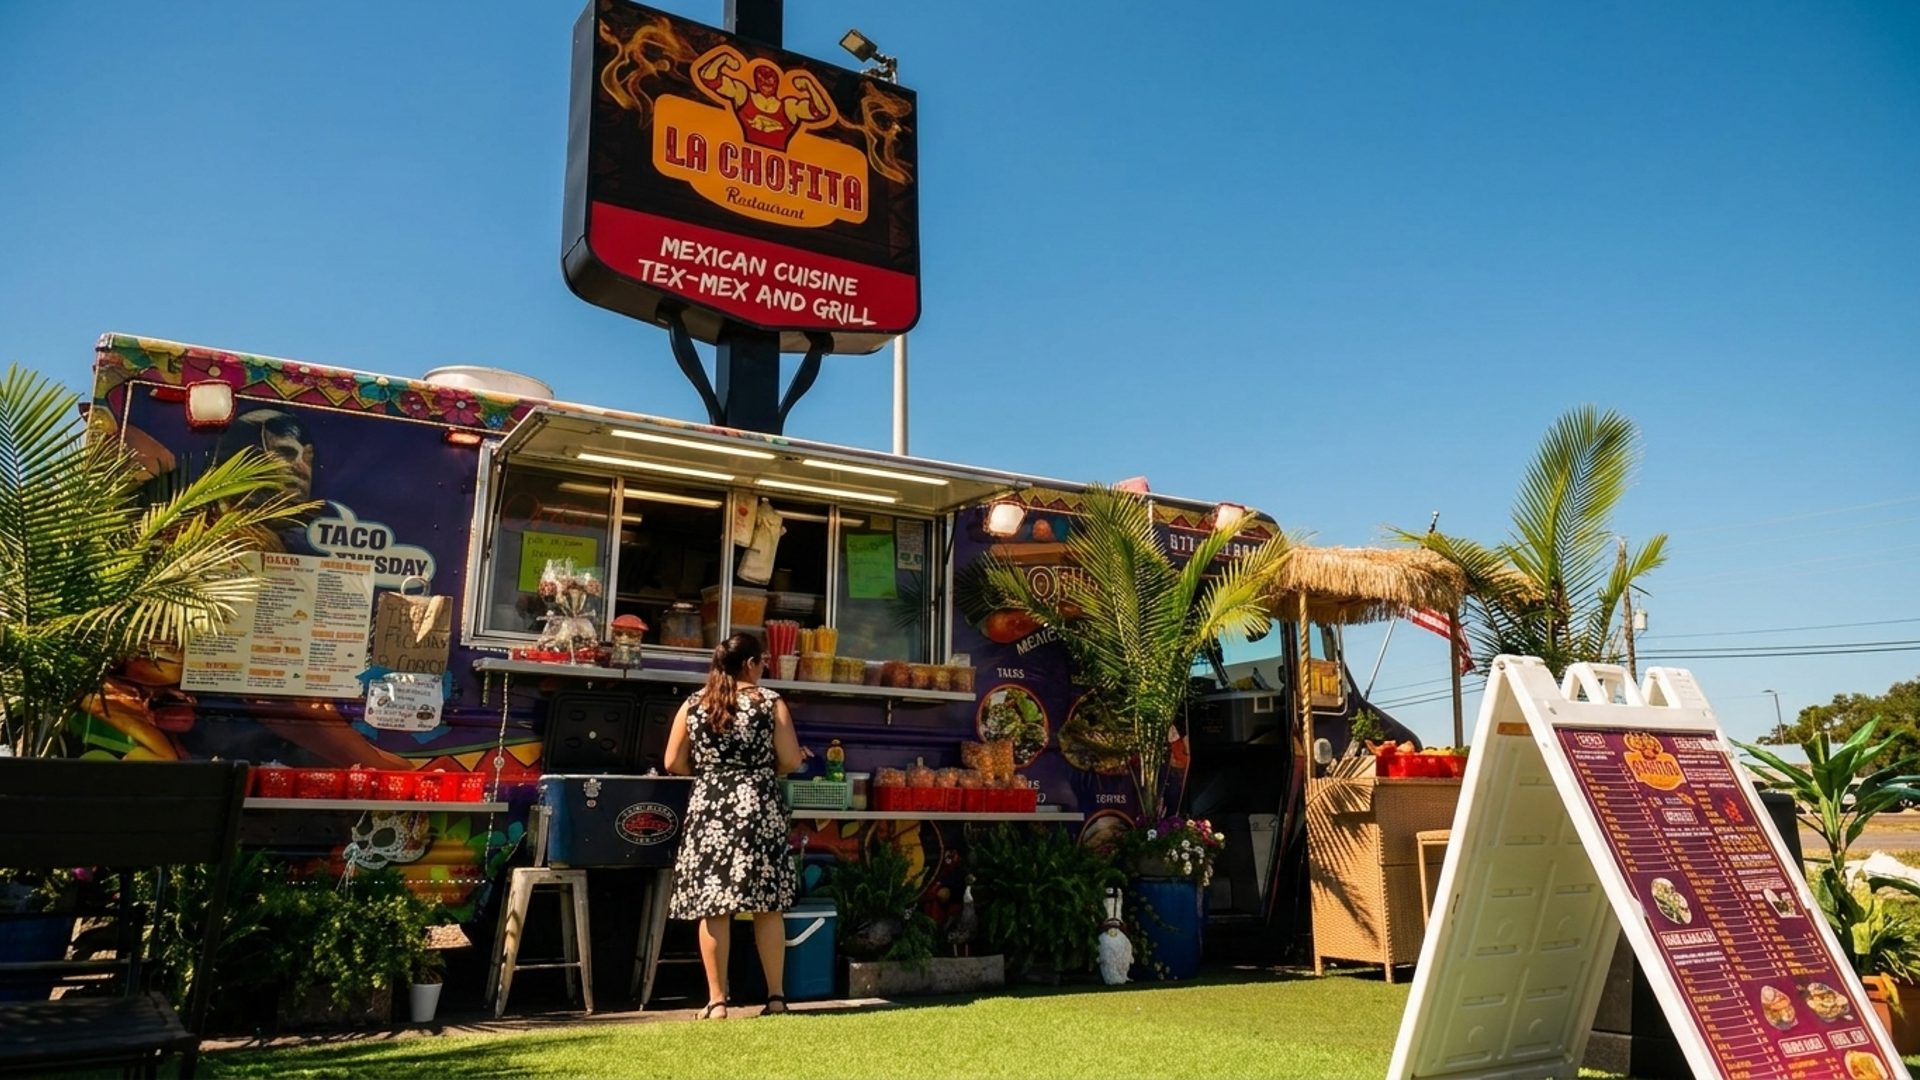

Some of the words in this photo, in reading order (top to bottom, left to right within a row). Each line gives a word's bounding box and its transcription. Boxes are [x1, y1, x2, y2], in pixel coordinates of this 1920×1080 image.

[665, 125, 708, 173] LA
[719, 141, 863, 212] CHOFITA
[638, 258, 750, 302] TEX-MEX
[756, 285, 806, 311] AND
[813, 298, 877, 327] GRILL
[660, 236, 766, 277] MEXICAN
[774, 263, 858, 297] CUISINE
[318, 524, 387, 550] TACO
